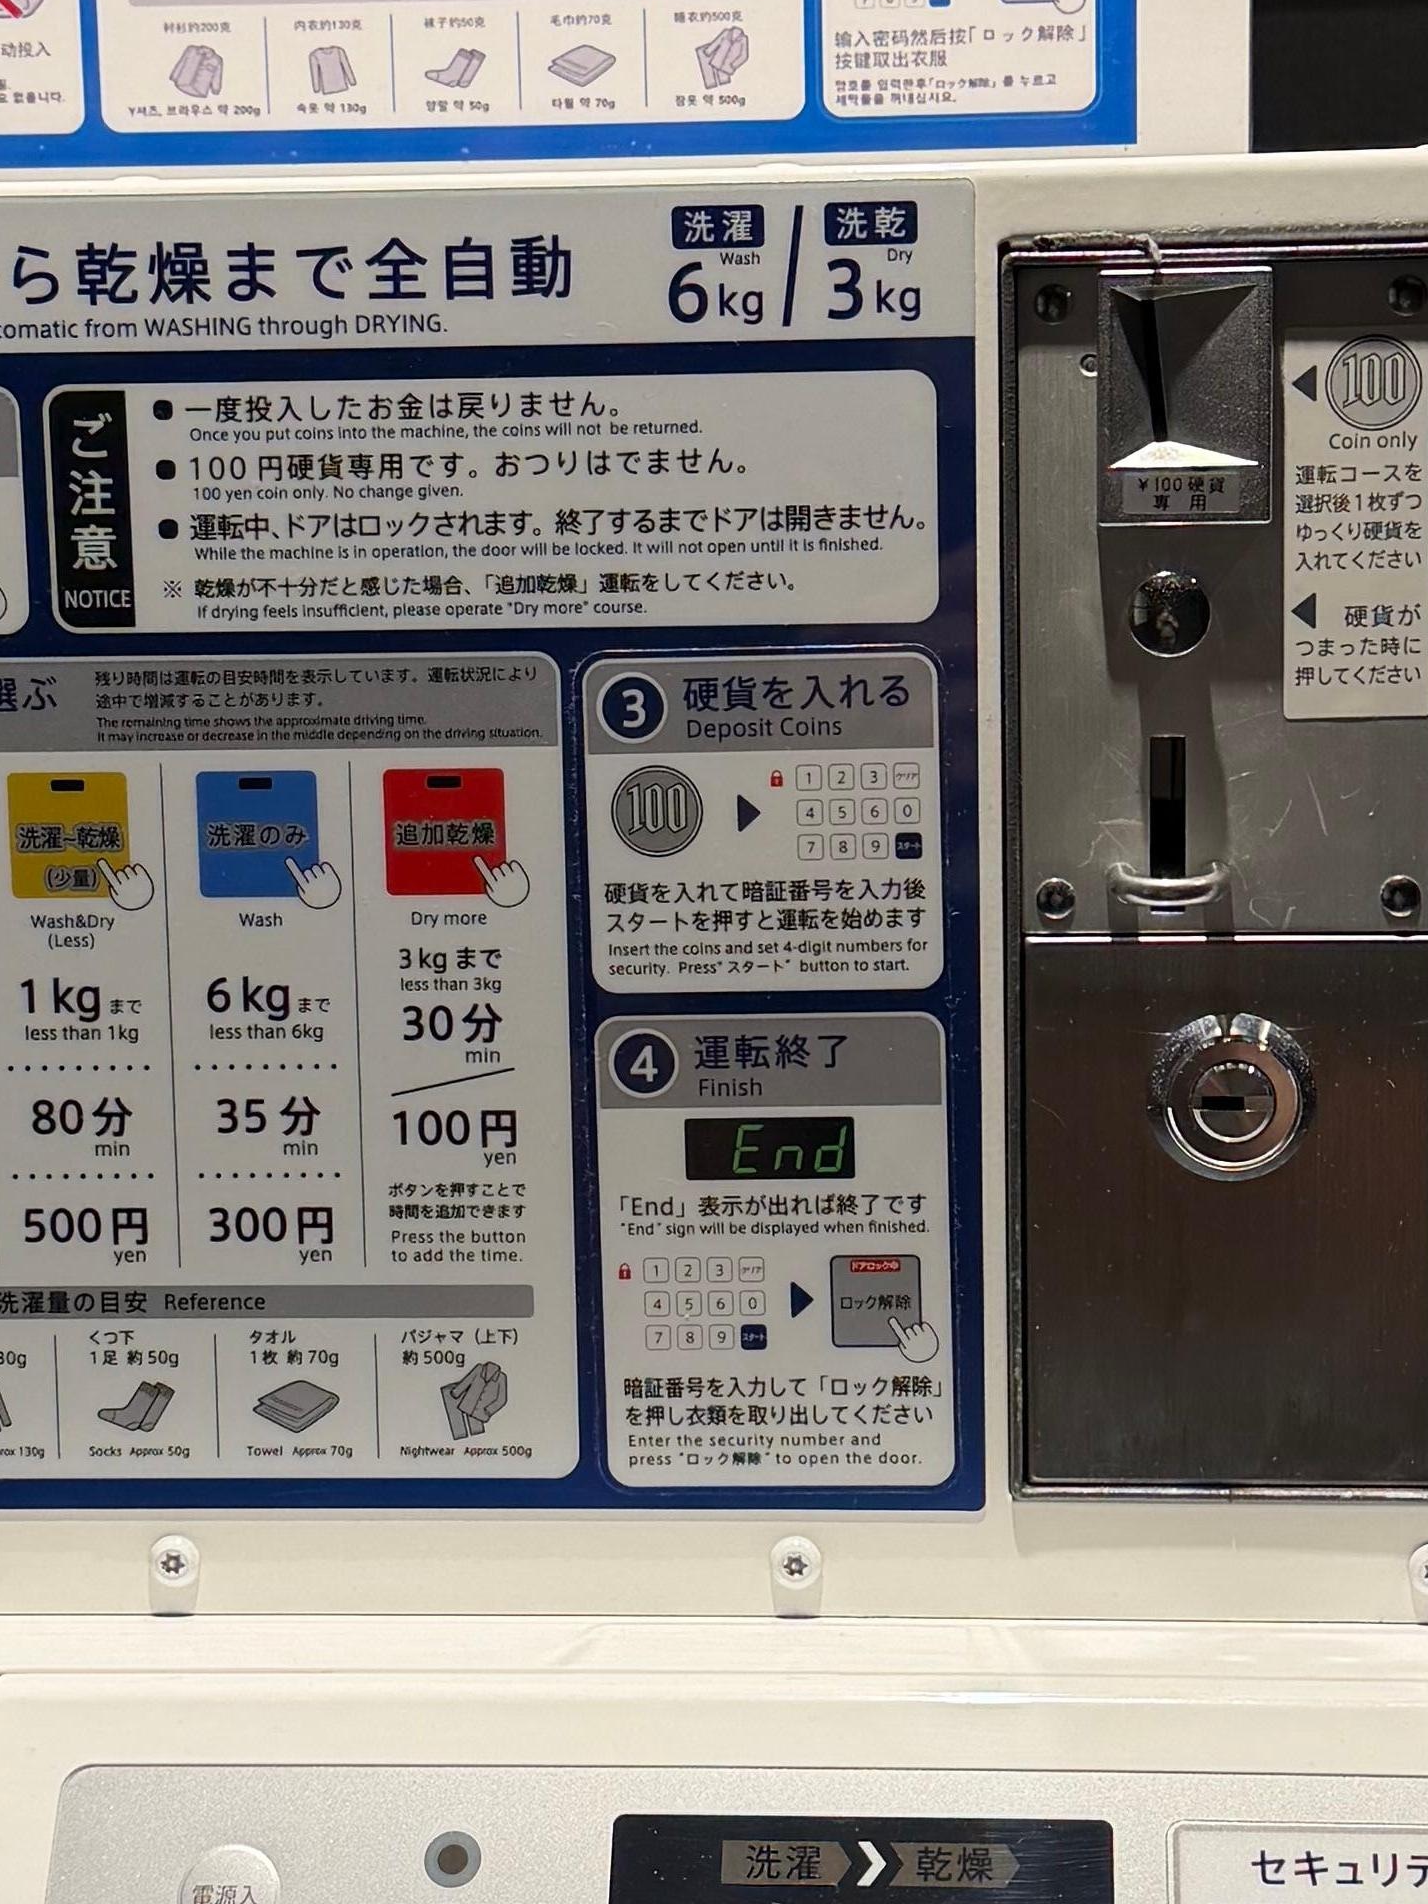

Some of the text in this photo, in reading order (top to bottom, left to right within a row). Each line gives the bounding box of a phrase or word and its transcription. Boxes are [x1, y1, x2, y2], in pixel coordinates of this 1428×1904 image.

[684, 211, 754, 243] 洗濯
[836, 208, 906, 240] 洗乾
[720, 251, 761, 266] Wash
[887, 248, 913, 264] Dry
[84, 318, 138, 339] from
[143, 316, 252, 338] WASHING
[257, 314, 348, 341] through
[355, 314, 448, 335] DRYING.
[1328, 432, 1418, 452] Coin only
[1294, 463, 1423, 484] 運転コースを
[69, 412, 117, 572] ご注意
[63, 588, 132, 610] NOTICE
[1343, 604, 1421, 628] 硬貨が
[682, 674, 910, 712] 硬貨を入れる
[686, 716, 843, 743] Deposit Coins
[694, 1034, 850, 1070] 運転終了
[698, 1078, 763, 1096] Finish
[732, 1124, 852, 1174] End
[164, 1293, 266, 1312] Reference
[744, 1844, 822, 1880] 洗濯
[915, 1847, 994, 1883] 乾燥
